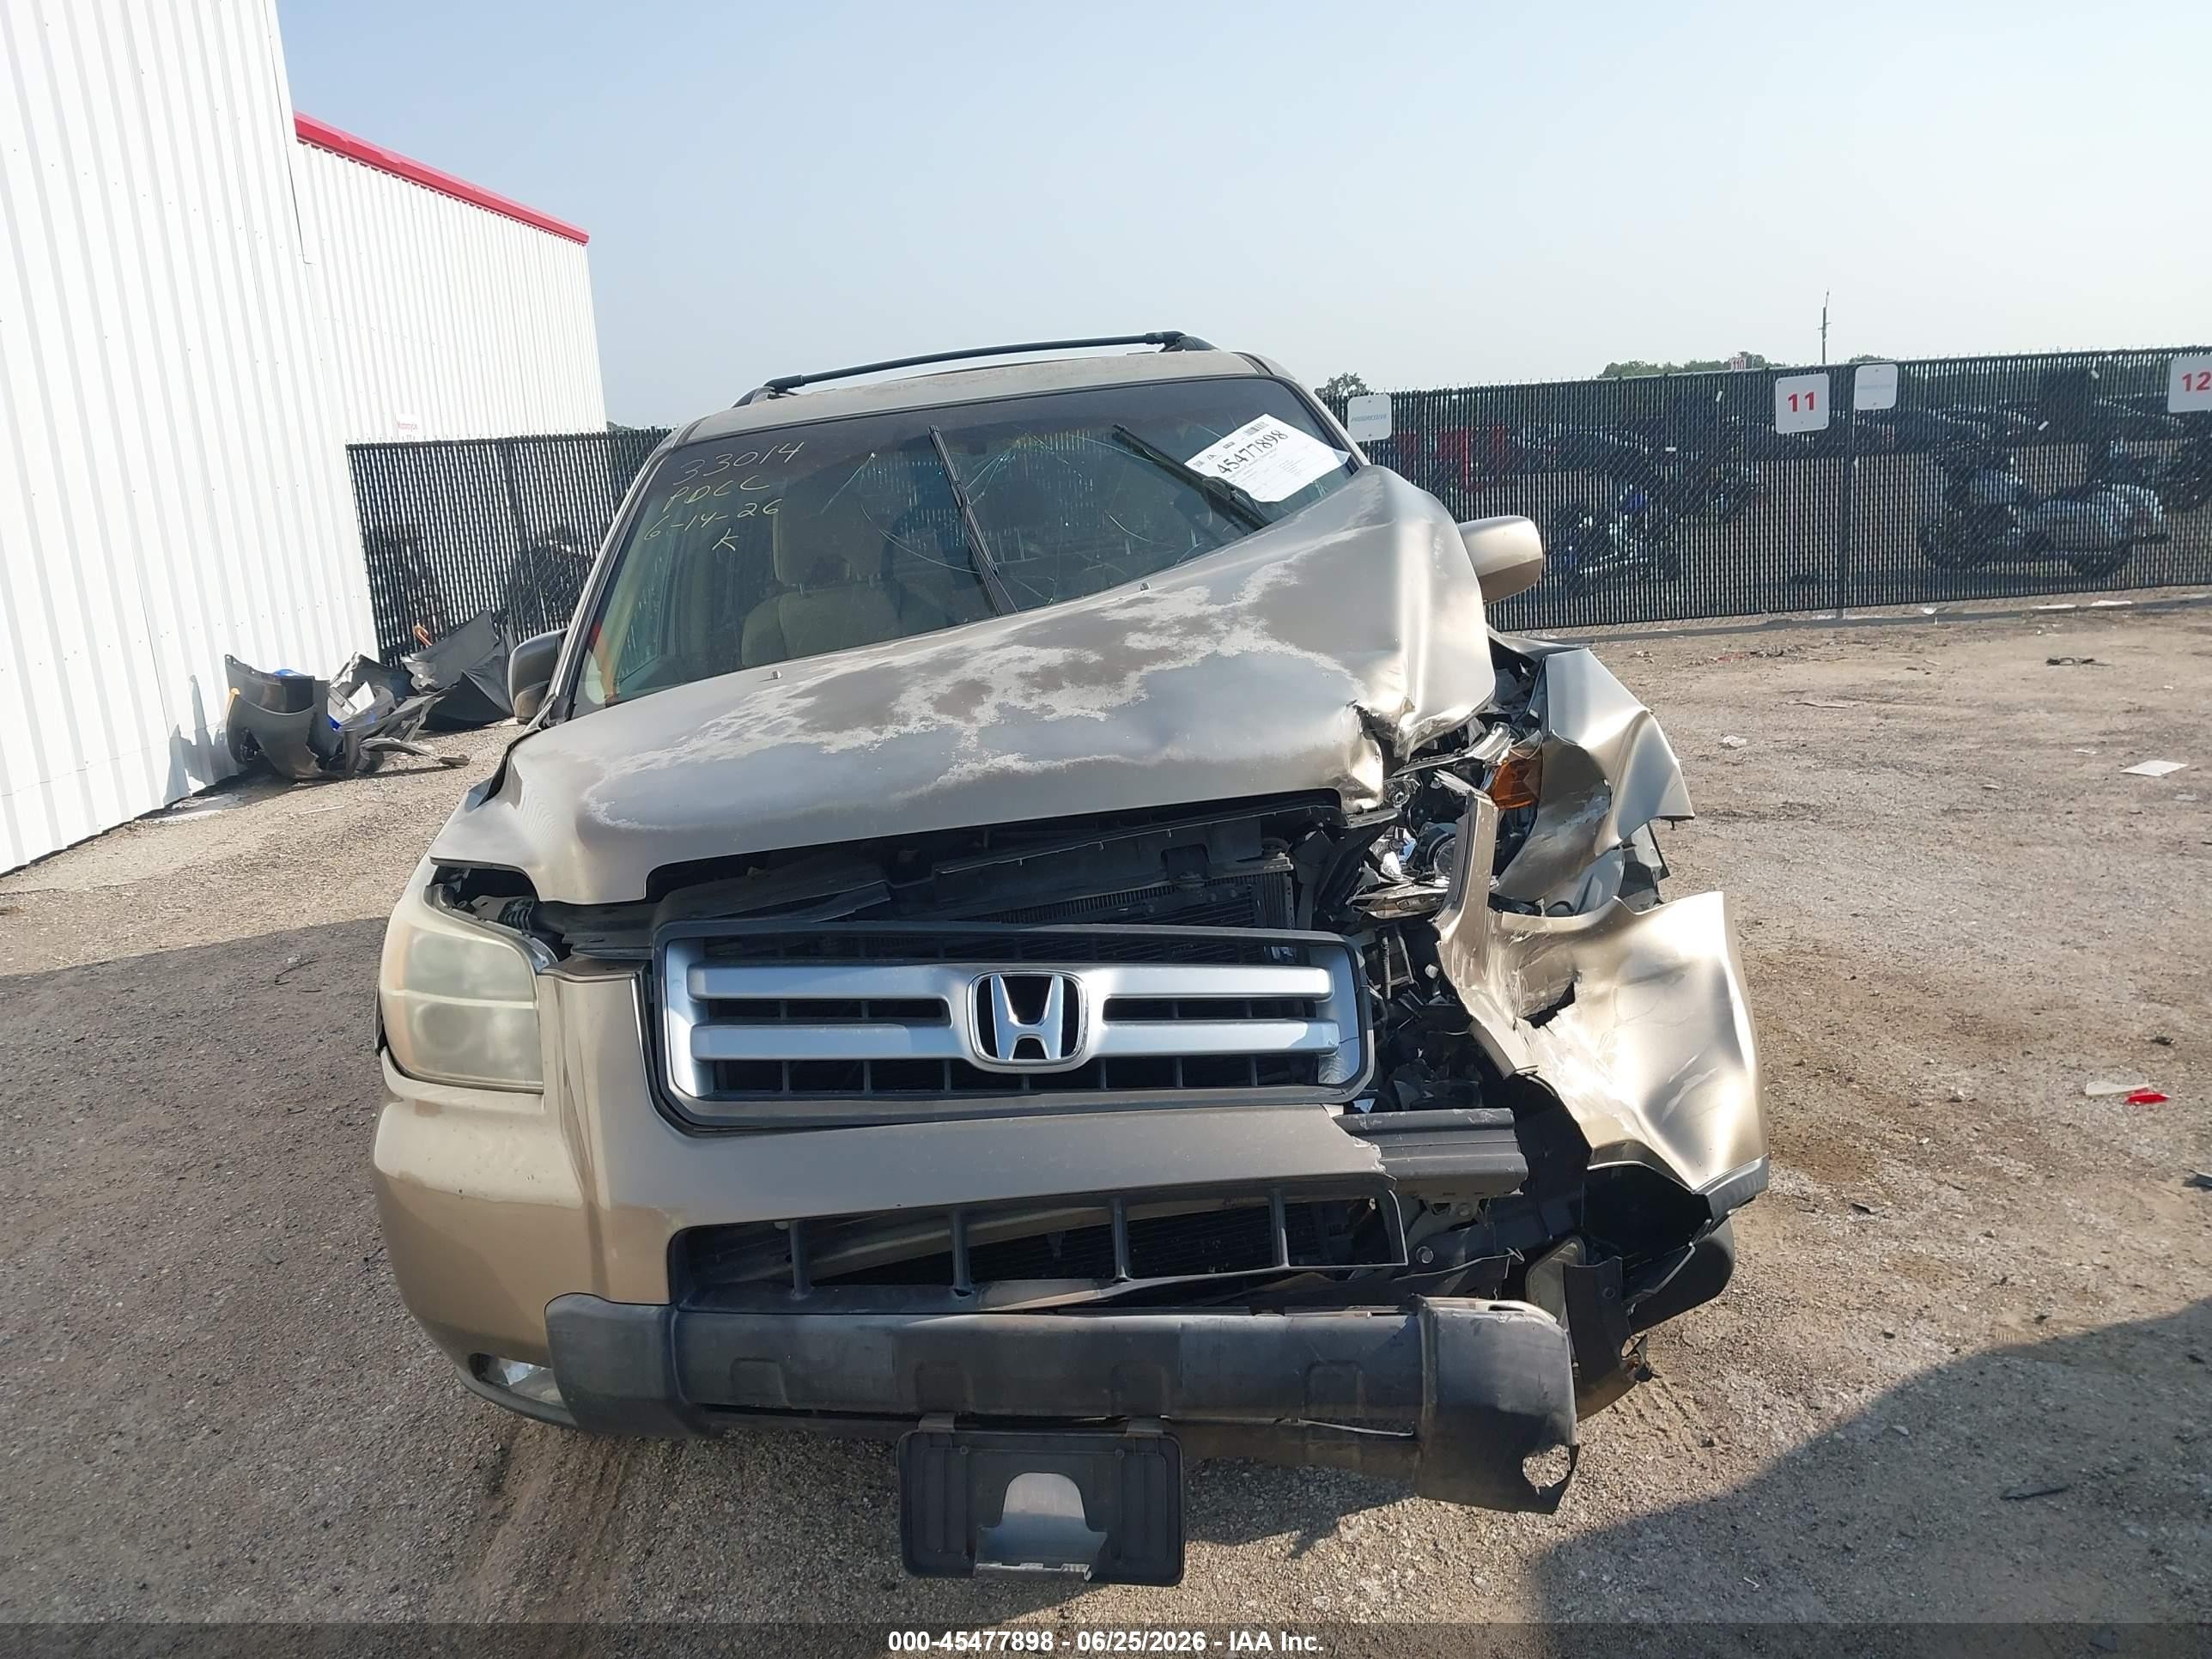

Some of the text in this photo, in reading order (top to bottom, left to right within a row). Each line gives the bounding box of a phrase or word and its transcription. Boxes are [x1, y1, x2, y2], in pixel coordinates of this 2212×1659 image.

[2182, 371, 2211, 392] 12
[1788, 392, 1814, 412] 11
[1217, 429, 1288, 474] 45477898
[644, 499, 782, 540] 6-14-26
[712, 528, 738, 551] K
